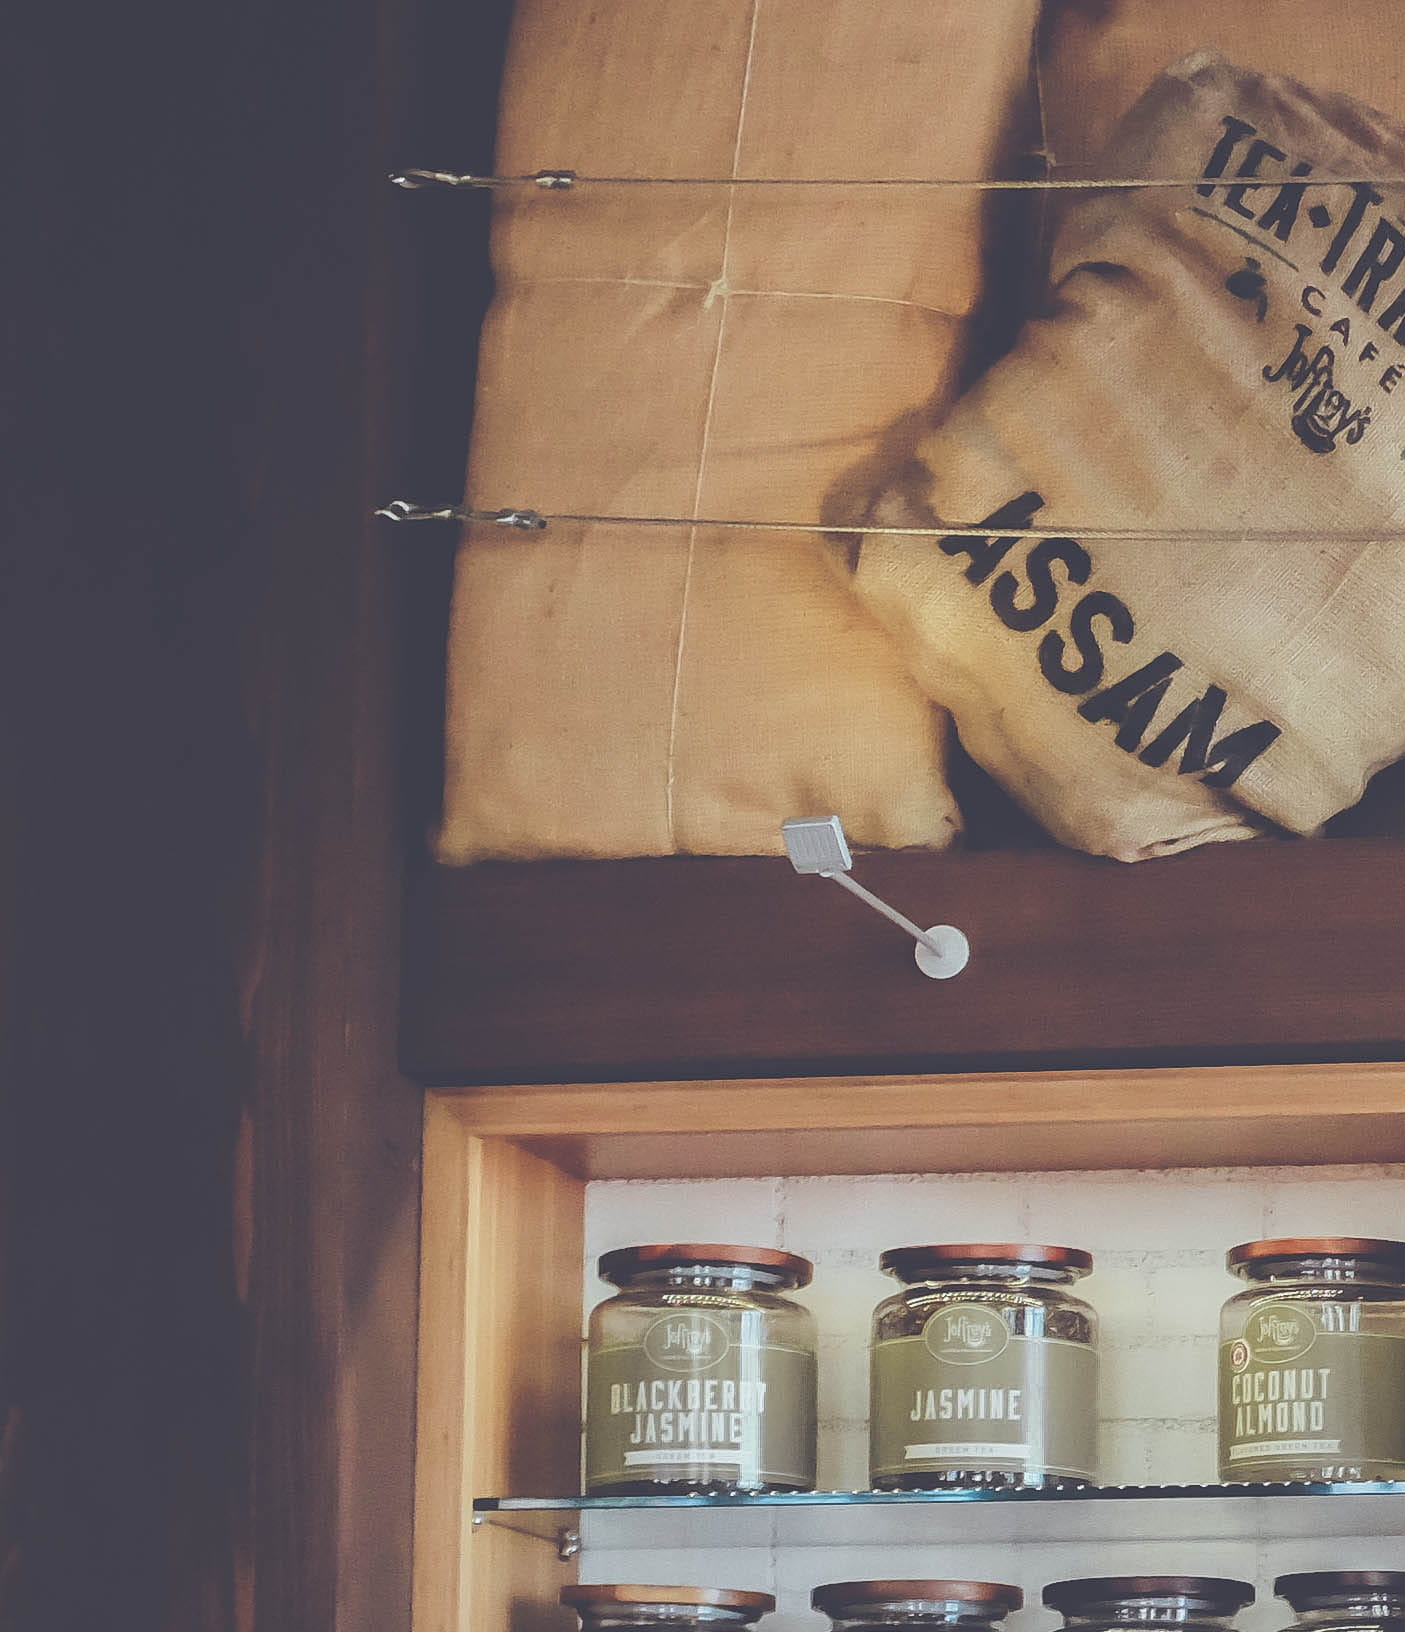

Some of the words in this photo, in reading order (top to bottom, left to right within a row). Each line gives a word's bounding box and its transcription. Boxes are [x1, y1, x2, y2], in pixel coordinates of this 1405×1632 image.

[939, 491, 1282, 788] ASSAM
[1231, 1369, 1331, 1405] COCONUT
[910, 1389, 1022, 1422] JASMINE
[1235, 1402, 1326, 1437] ALMOND
[630, 1413, 744, 1444] JASMINE
